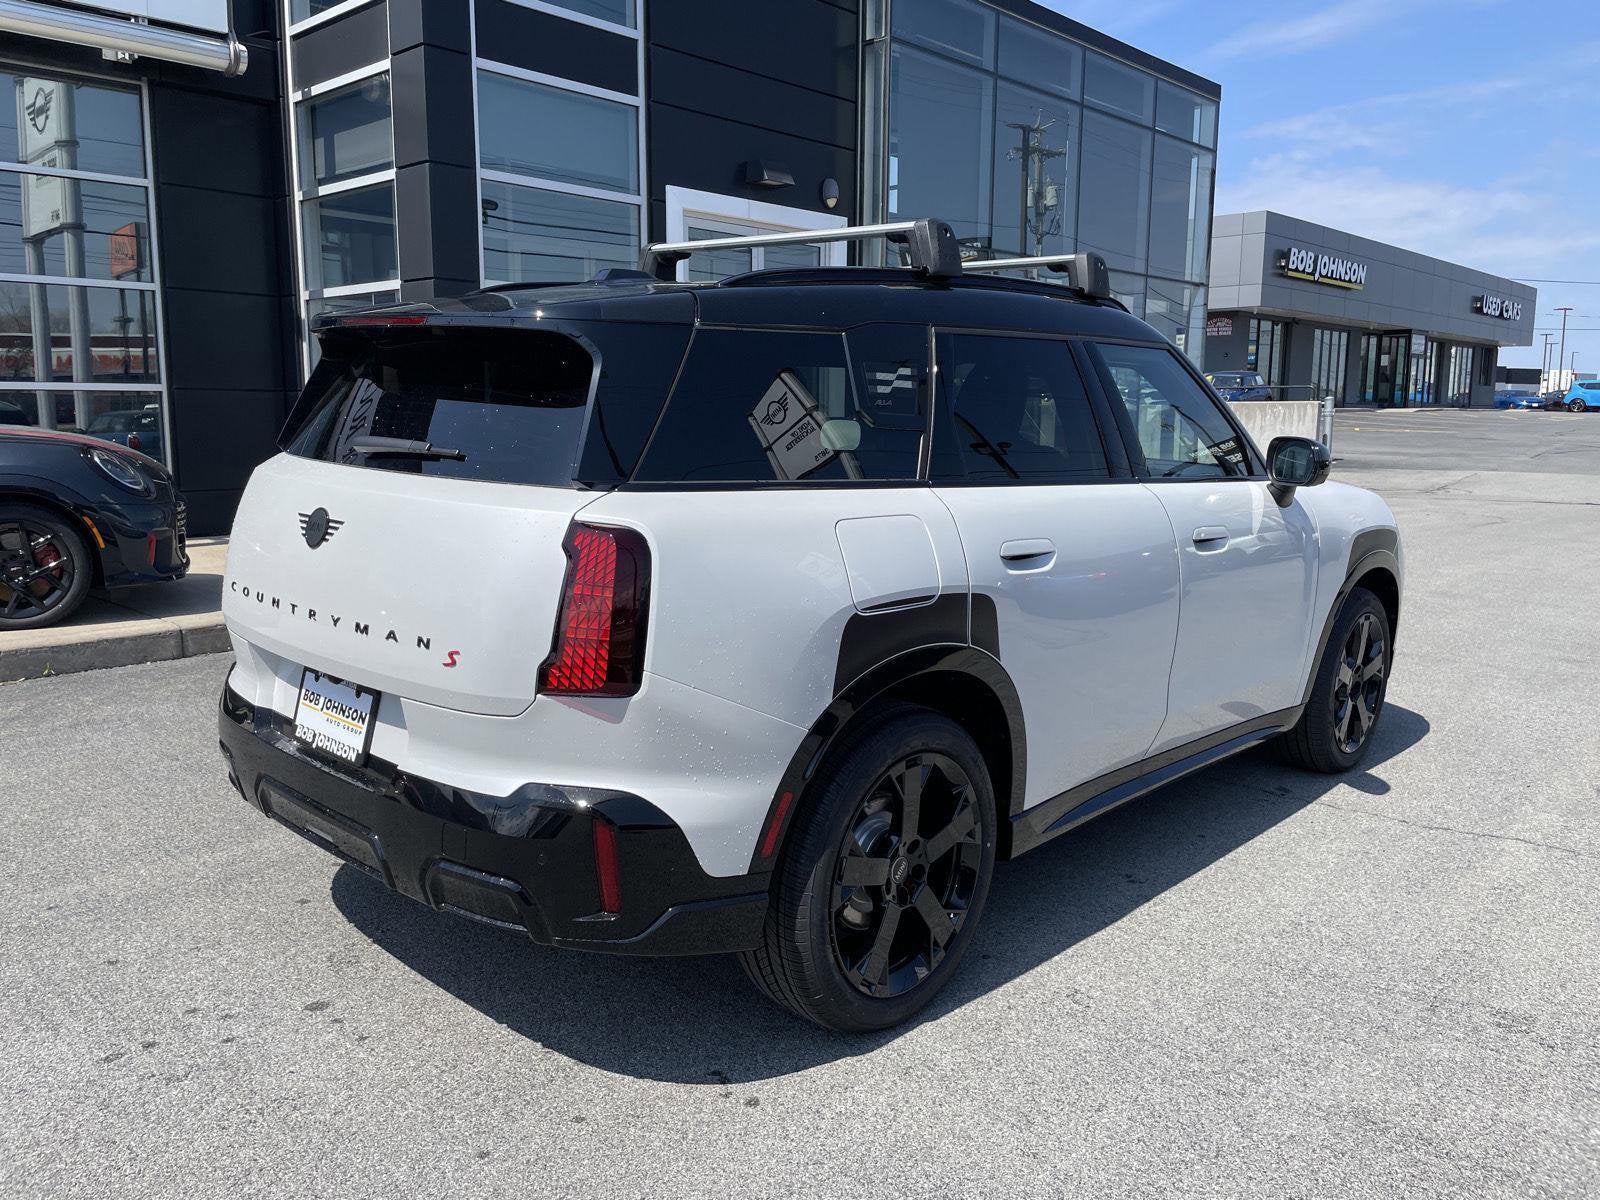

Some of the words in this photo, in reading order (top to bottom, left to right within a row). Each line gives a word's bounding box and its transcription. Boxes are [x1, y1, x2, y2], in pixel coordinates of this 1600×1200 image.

[1289, 248, 1314, 272] BOB
[1315, 254, 1367, 284] JOHNSON
[1483, 294, 1500, 316] USED
[1503, 300, 1521, 320] CARS
[231, 581, 430, 650] COUNTRYMAN
[442, 650, 460, 668] S
[303, 689, 321, 706] BOB
[321, 697, 368, 725] JOHNSON
[295, 724, 314, 742] BOB
[312, 733, 358, 762] JOHNSON
[326, 718, 340, 727] AUTO
[343, 724, 362, 735] GROUP
